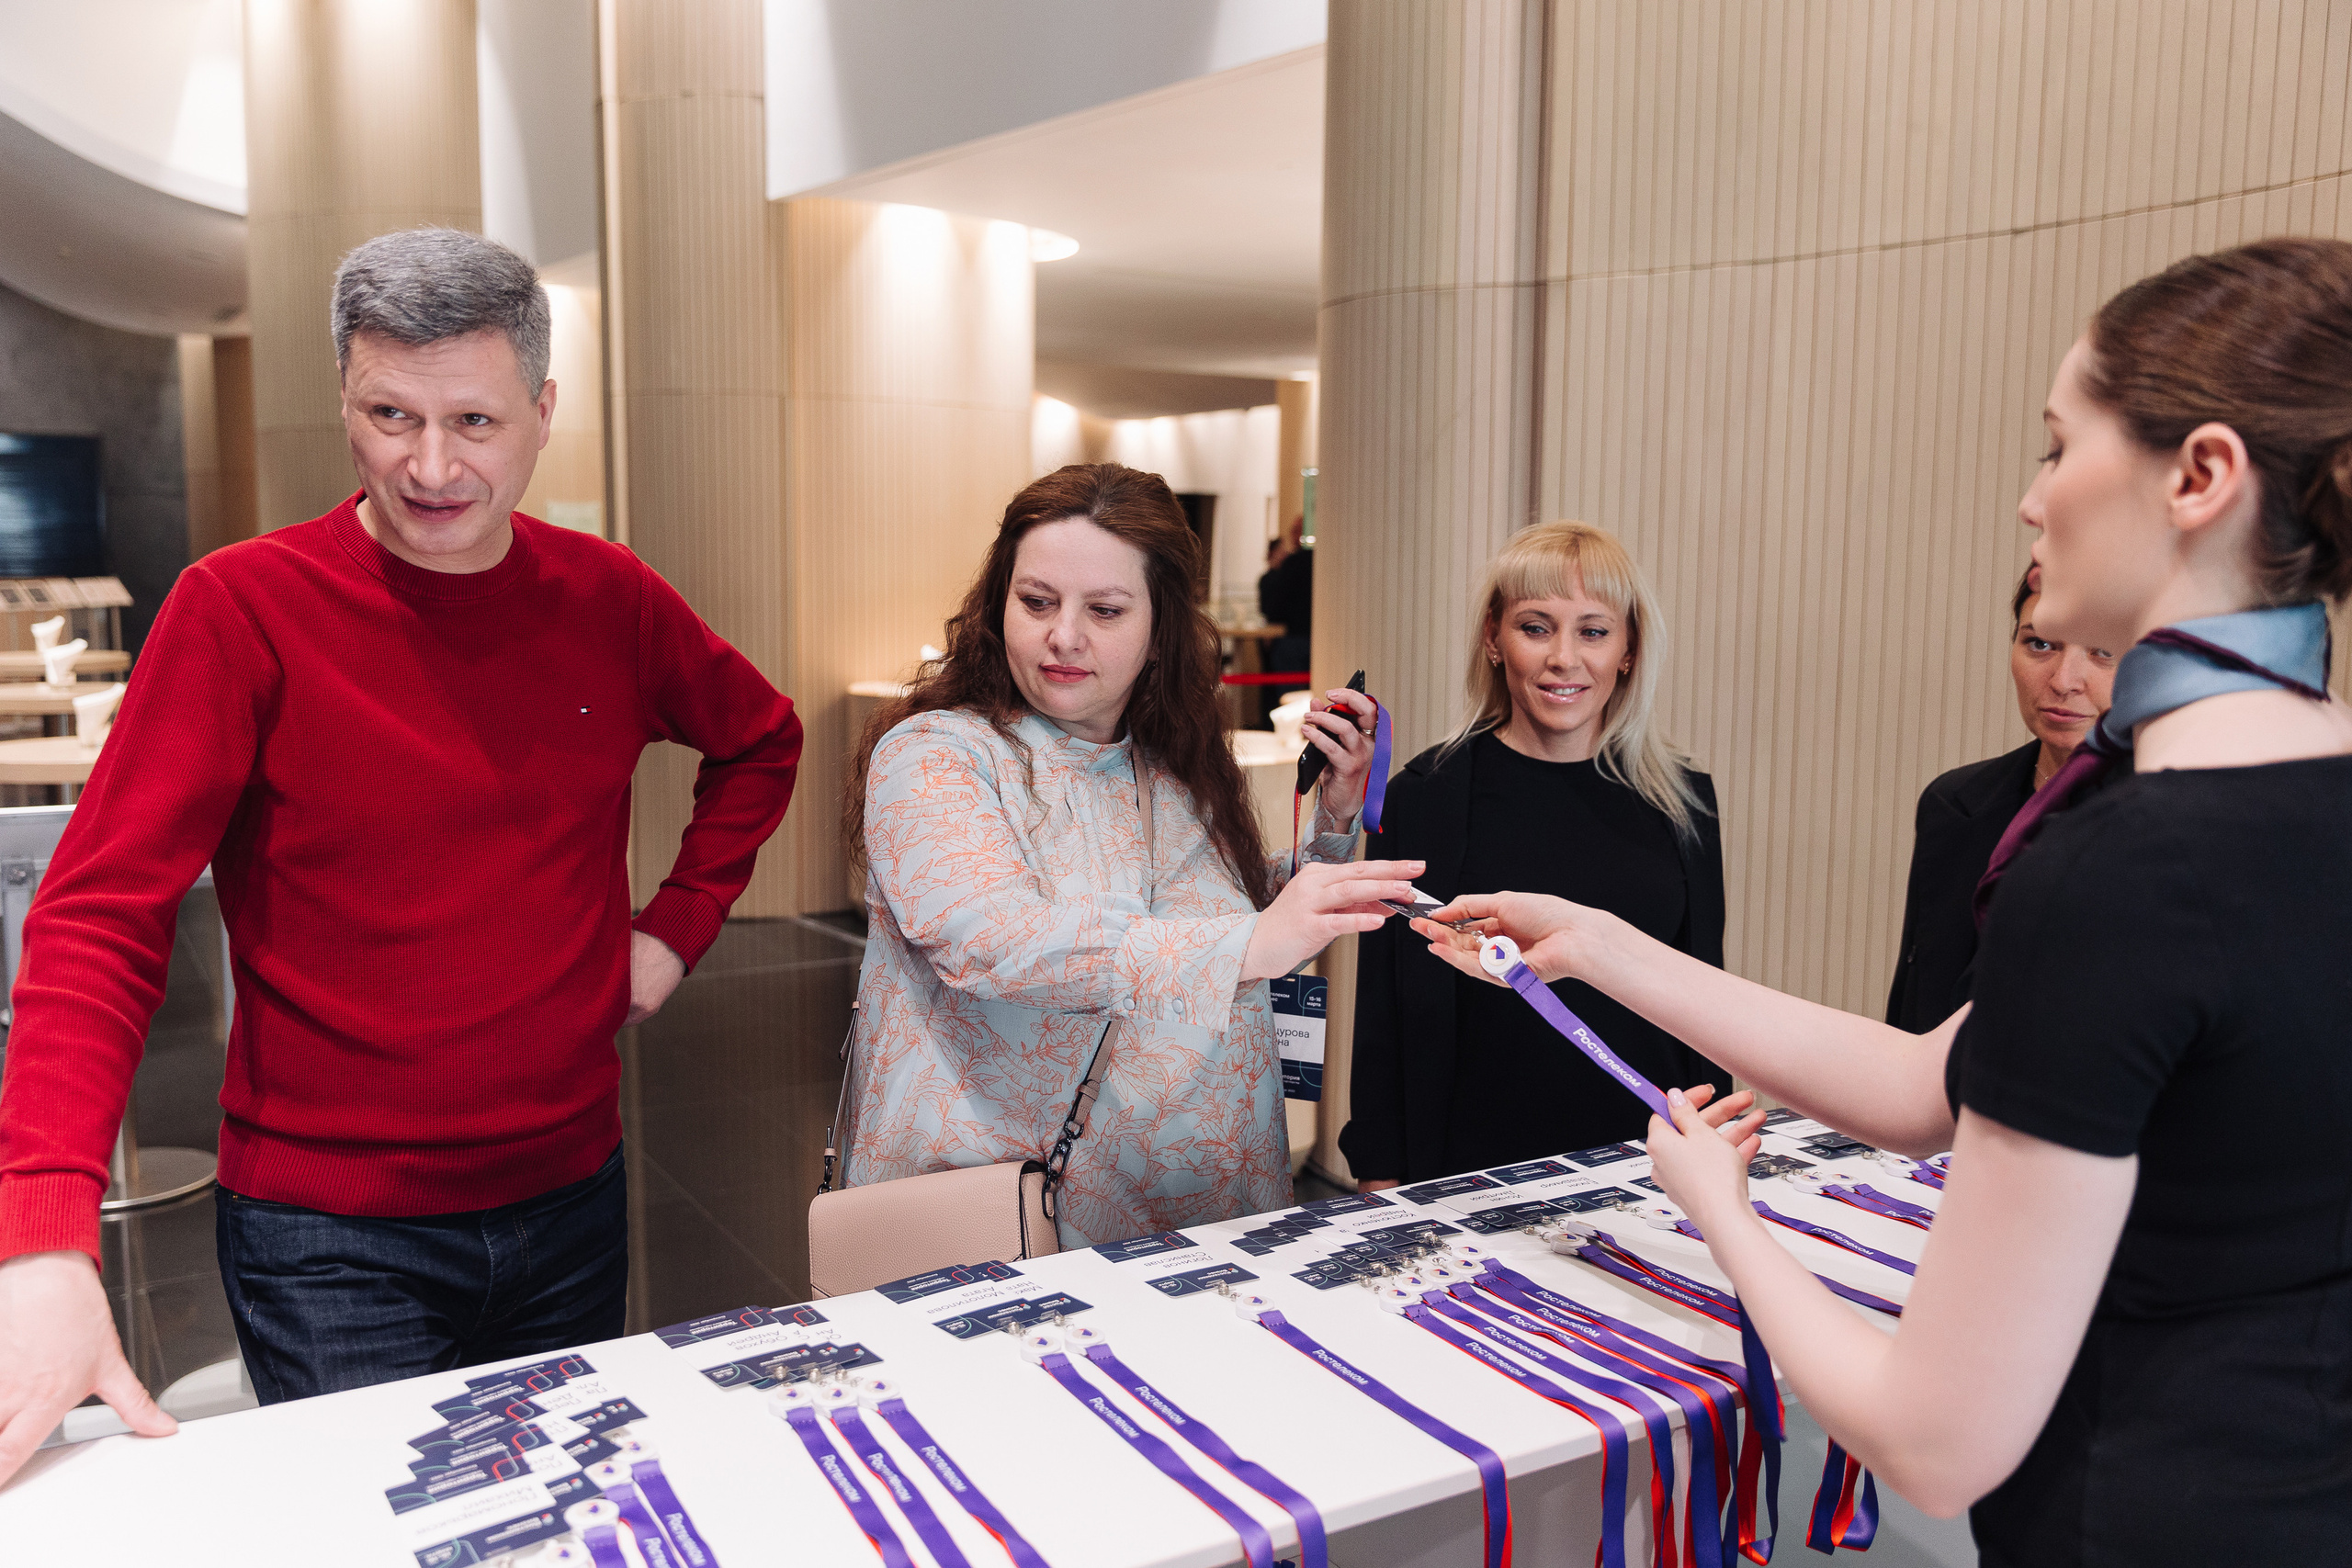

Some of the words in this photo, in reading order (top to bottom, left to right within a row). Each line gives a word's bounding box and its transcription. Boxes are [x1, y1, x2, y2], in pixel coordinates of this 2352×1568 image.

[1572, 1027, 1643, 1089] Ростелеком
[1143, 1251, 1206, 1268] Станислав
[1162, 1255, 1214, 1269] Логинов
[961, 1286, 995, 1298] Агата
[1639, 1276, 1706, 1306] Ростелеком
[1654, 1268, 1719, 1297] Ростелеком
[925, 1290, 1005, 1315] Молотилова
[1535, 1290, 1603, 1318] Ростелеком
[1535, 1307, 1602, 1338] Ростелеком
[727, 1330, 780, 1347] Андрей
[733, 1335, 788, 1351] Обухов
[1483, 1325, 1548, 1360] Ростелеком
[1312, 1348, 1369, 1385] Ростелеком
[1464, 1341, 1528, 1378] Ростелеком
[1089, 1396, 1141, 1438] Ростелеком
[1135, 1385, 1187, 1427] Ростелеком
[820, 1453, 863, 1503] Ростелеком
[866, 1452, 913, 1503] Ростелеком
[920, 1445, 969, 1493] Ростелеком
[462, 1485, 532, 1511] Михаил
